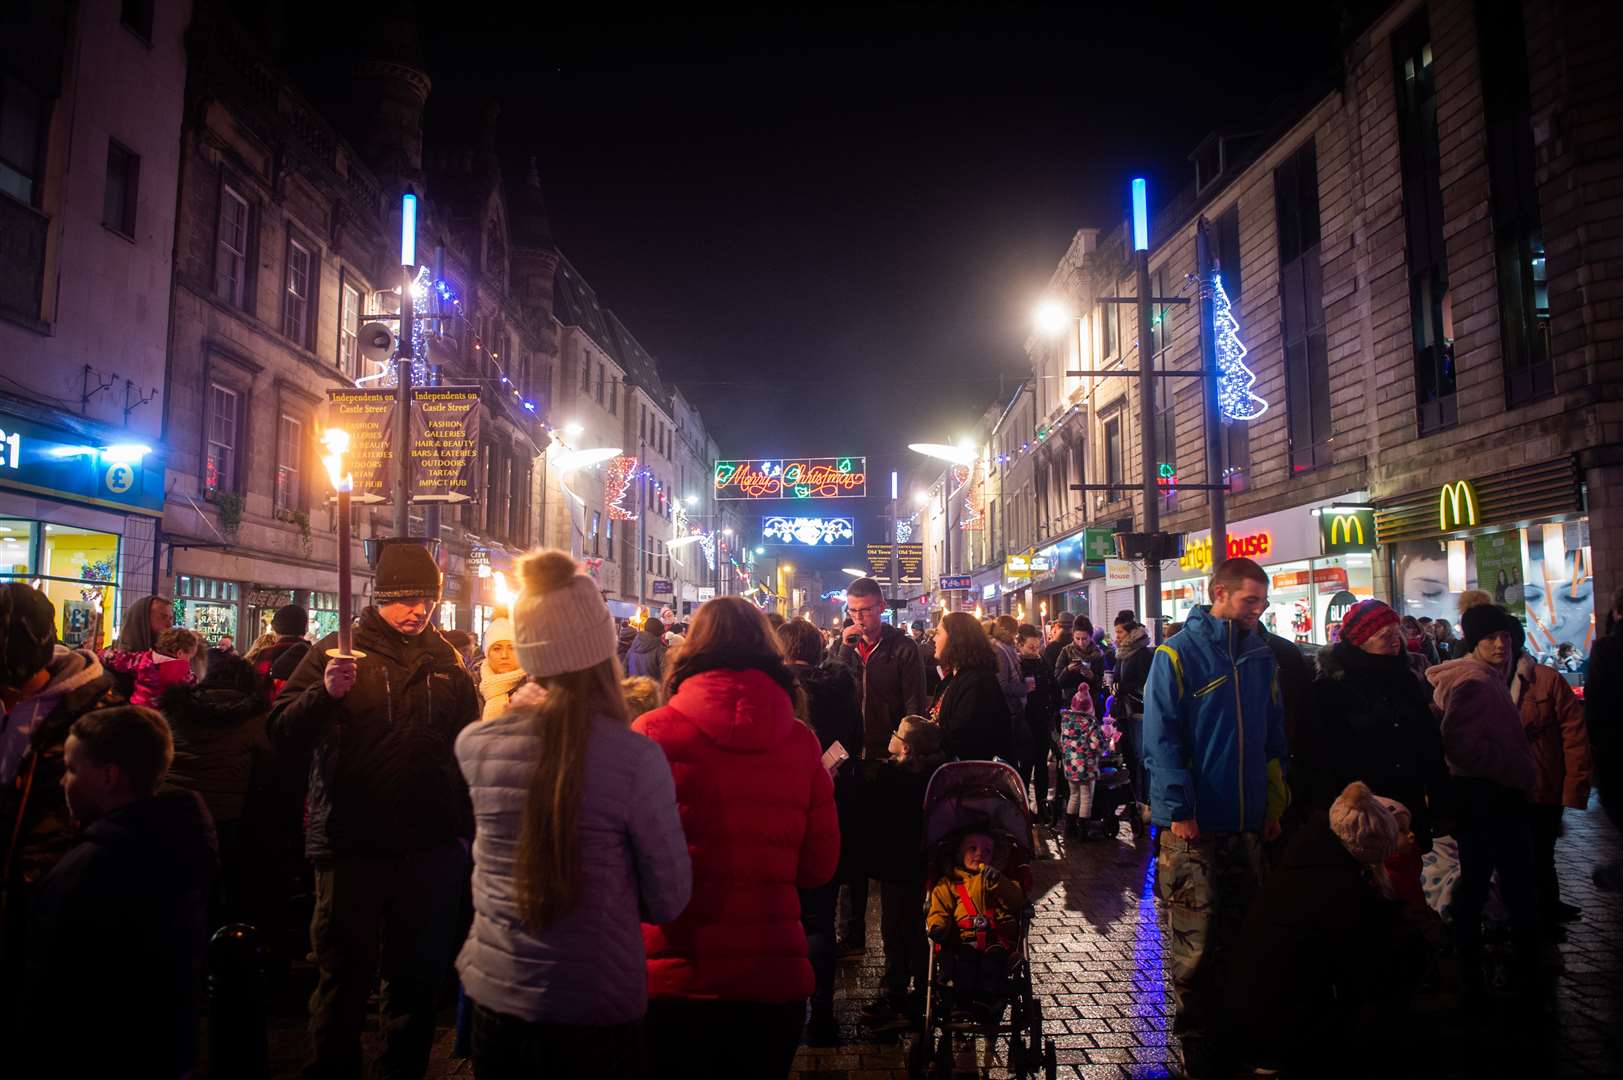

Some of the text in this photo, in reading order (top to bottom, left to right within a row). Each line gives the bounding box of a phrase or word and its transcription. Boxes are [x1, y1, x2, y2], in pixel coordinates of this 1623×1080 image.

[333, 393, 383, 404] Independents
[415, 391, 465, 402] Independents
[340, 405, 387, 413] Castle Street
[422, 403, 470, 412] Castle Street
[716, 463, 865, 497] Merry Christmas
